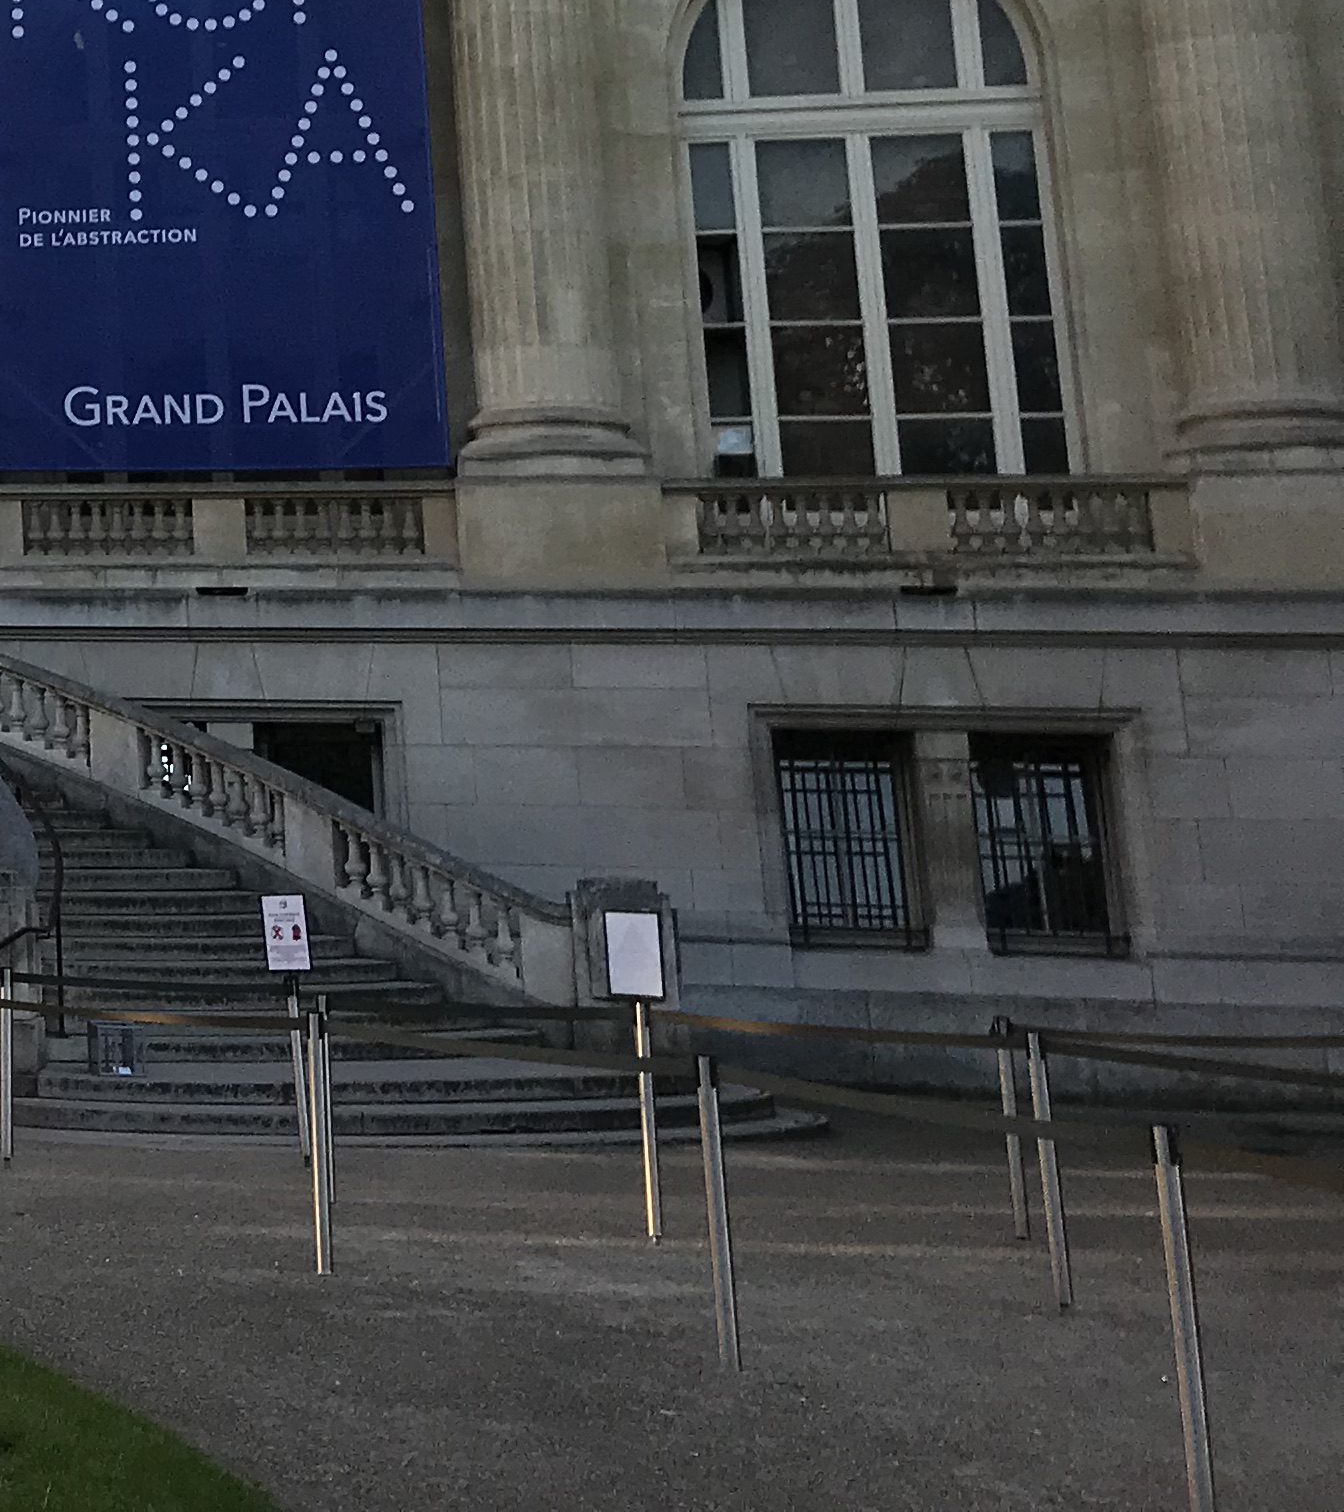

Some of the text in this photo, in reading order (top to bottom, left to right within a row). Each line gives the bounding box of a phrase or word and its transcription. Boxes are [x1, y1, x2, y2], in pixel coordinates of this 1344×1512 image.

[123, 48, 415, 220] KA
[18, 207, 111, 226] PIONNIER
[19, 228, 197, 248] DE L'ABSTRACTION
[64, 384, 388, 426] GRAND PALAIS
